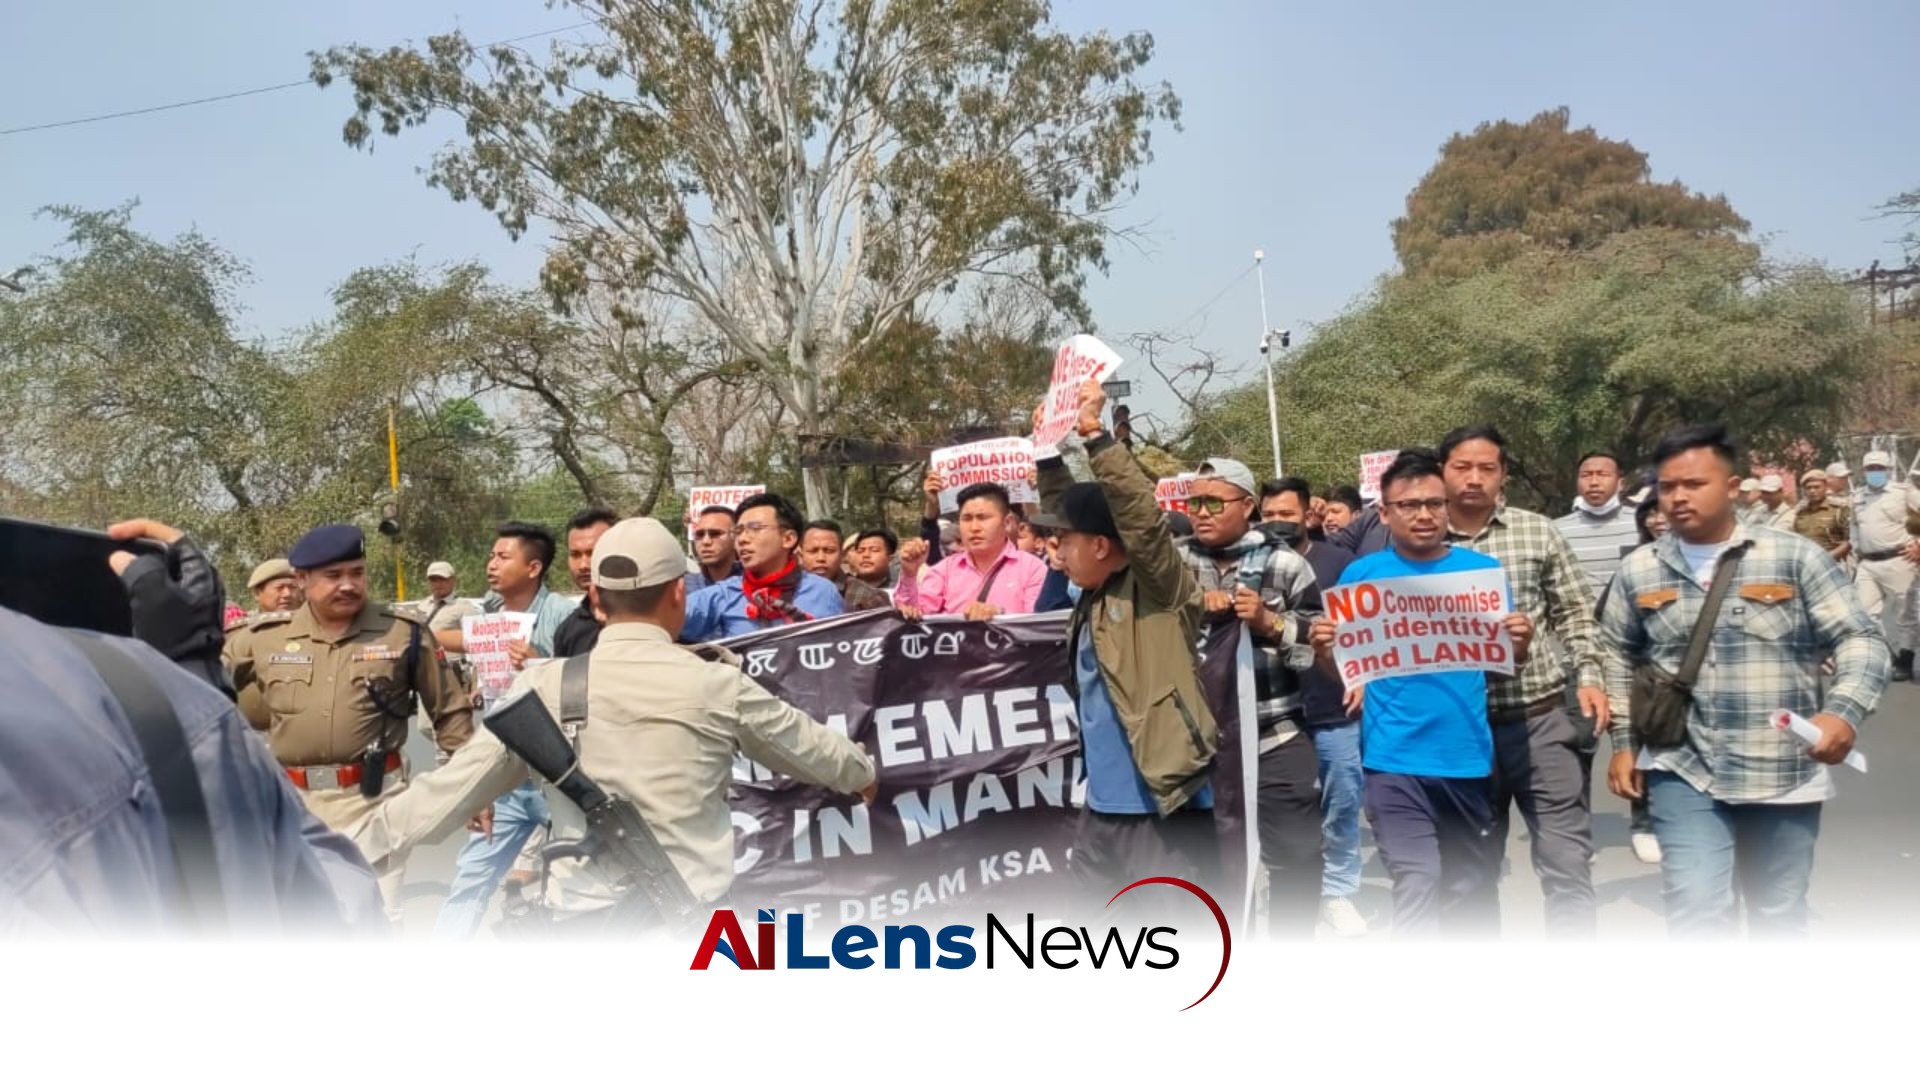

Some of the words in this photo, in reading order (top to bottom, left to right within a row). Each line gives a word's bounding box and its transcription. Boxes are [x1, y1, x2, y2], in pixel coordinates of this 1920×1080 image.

[941, 466, 1027, 489] COMMISSIO
[1326, 583, 1381, 623] NO
[1383, 585, 1500, 618] Compromise
[1339, 627, 1373, 648] on
[1382, 616, 1500, 641] identity
[1344, 647, 1400, 679] and
[1411, 642, 1506, 665] LAND
[793, 802, 872, 863] IN
[839, 866, 966, 925] DESAM
[979, 846, 1053, 886] KSA
